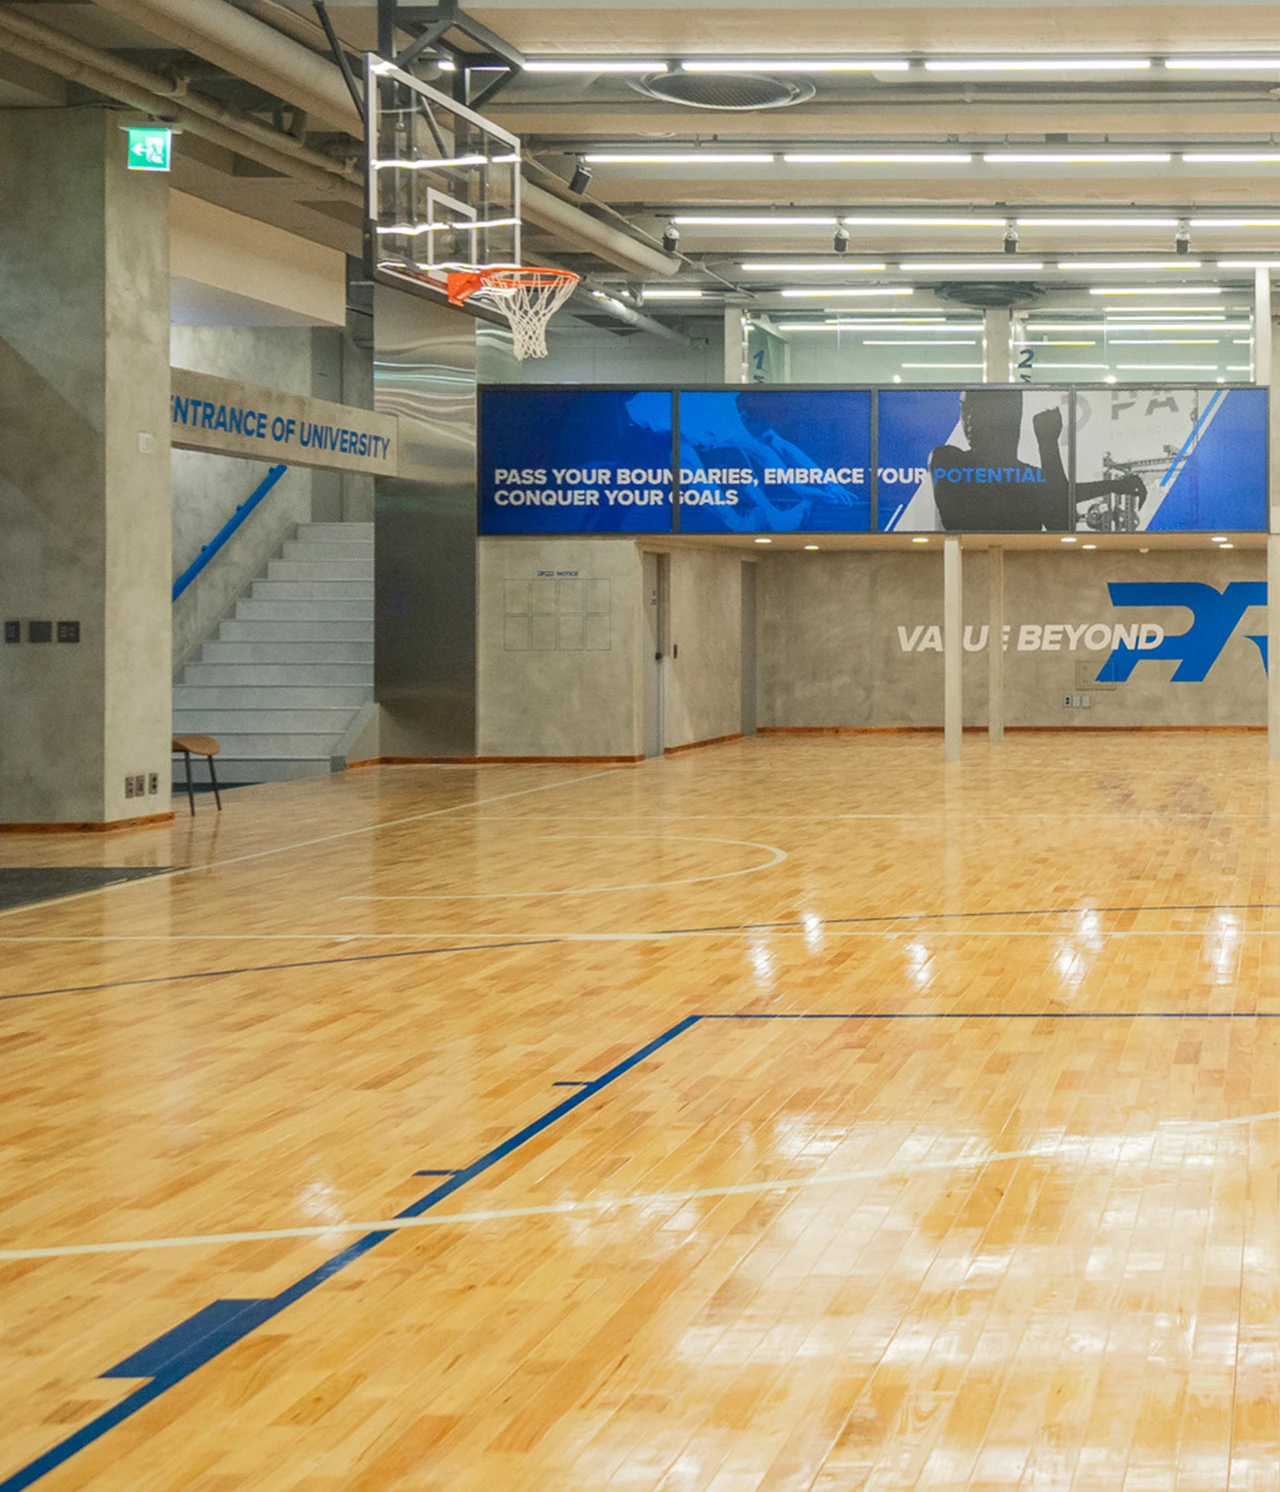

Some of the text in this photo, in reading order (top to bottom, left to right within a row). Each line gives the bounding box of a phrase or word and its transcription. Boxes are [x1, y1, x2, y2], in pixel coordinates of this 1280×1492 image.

[1017, 349, 1035, 368] 2
[171, 395, 390, 460] NTRANCE OF UNIVERSITY
[494, 468, 547, 485] PASS
[552, 468, 611, 485] YOUR
[764, 468, 864, 485] EMBRACE
[933, 467, 1047, 484] POTENTIAL
[494, 490, 600, 506] CONQUER
[604, 490, 664, 506] YOUR
[897, 623, 1164, 652] VAU BEYOND
